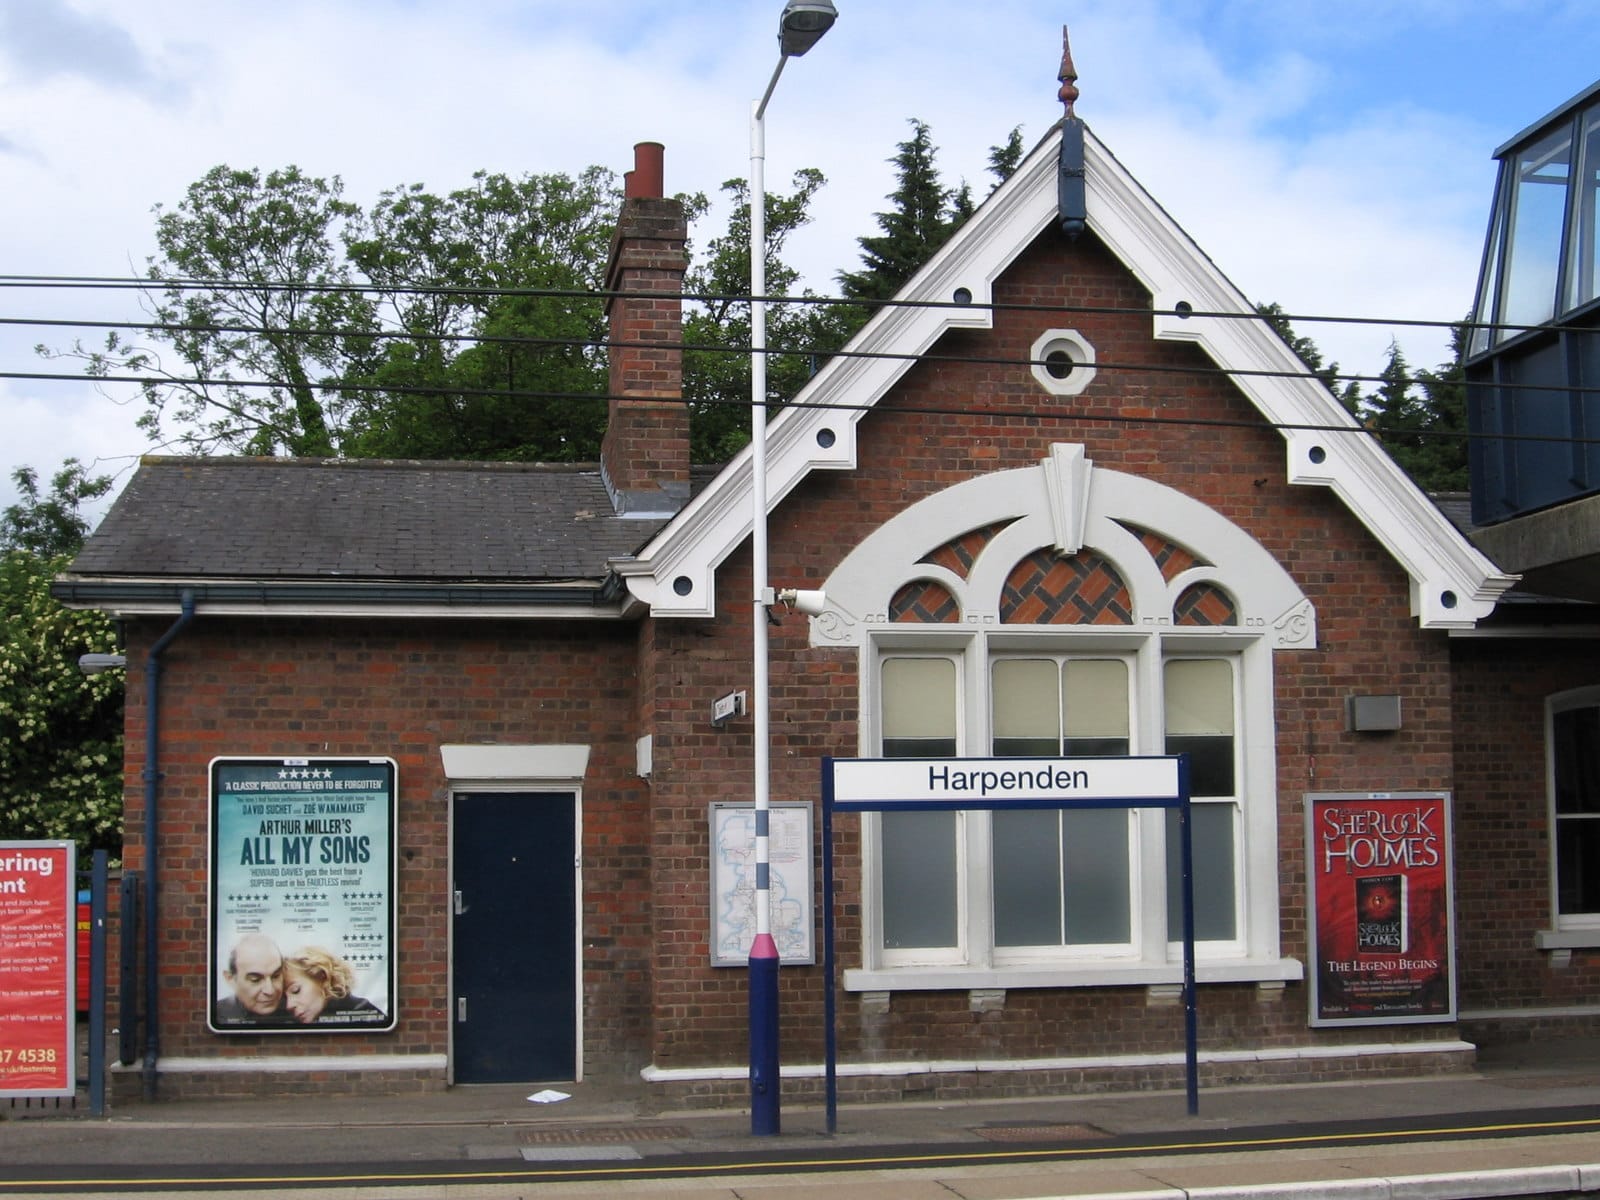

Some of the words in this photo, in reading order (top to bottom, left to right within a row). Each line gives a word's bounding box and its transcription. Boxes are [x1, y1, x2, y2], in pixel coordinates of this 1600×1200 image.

[232, 781, 260, 791] CLASSIC
[302, 780, 324, 790] NEVER
[325, 780, 334, 790] TO
[335, 780, 344, 790] BE
[928, 765, 1089, 797] Harpenden
[242, 804, 265, 815] DAVID
[265, 804, 293, 815] SUCHET
[259, 820, 301, 836] ARTHUR
[304, 819, 352, 835] MILLER'S
[1323, 807, 1437, 842] SHERLOCK
[240, 837, 276, 866] ALL
[282, 836, 314, 865] MY
[320, 836, 371, 865] SONS
[1323, 834, 1440, 874] HOLMES
[0, 877, 27, 894] nt
[1359, 933, 1400, 946] HOLMES
[1327, 960, 1351, 972] THE
[1353, 960, 1396, 972] LEGEND
[1399, 958, 1438, 970] BEGINS
[17, 1049, 56, 1063] 4538
